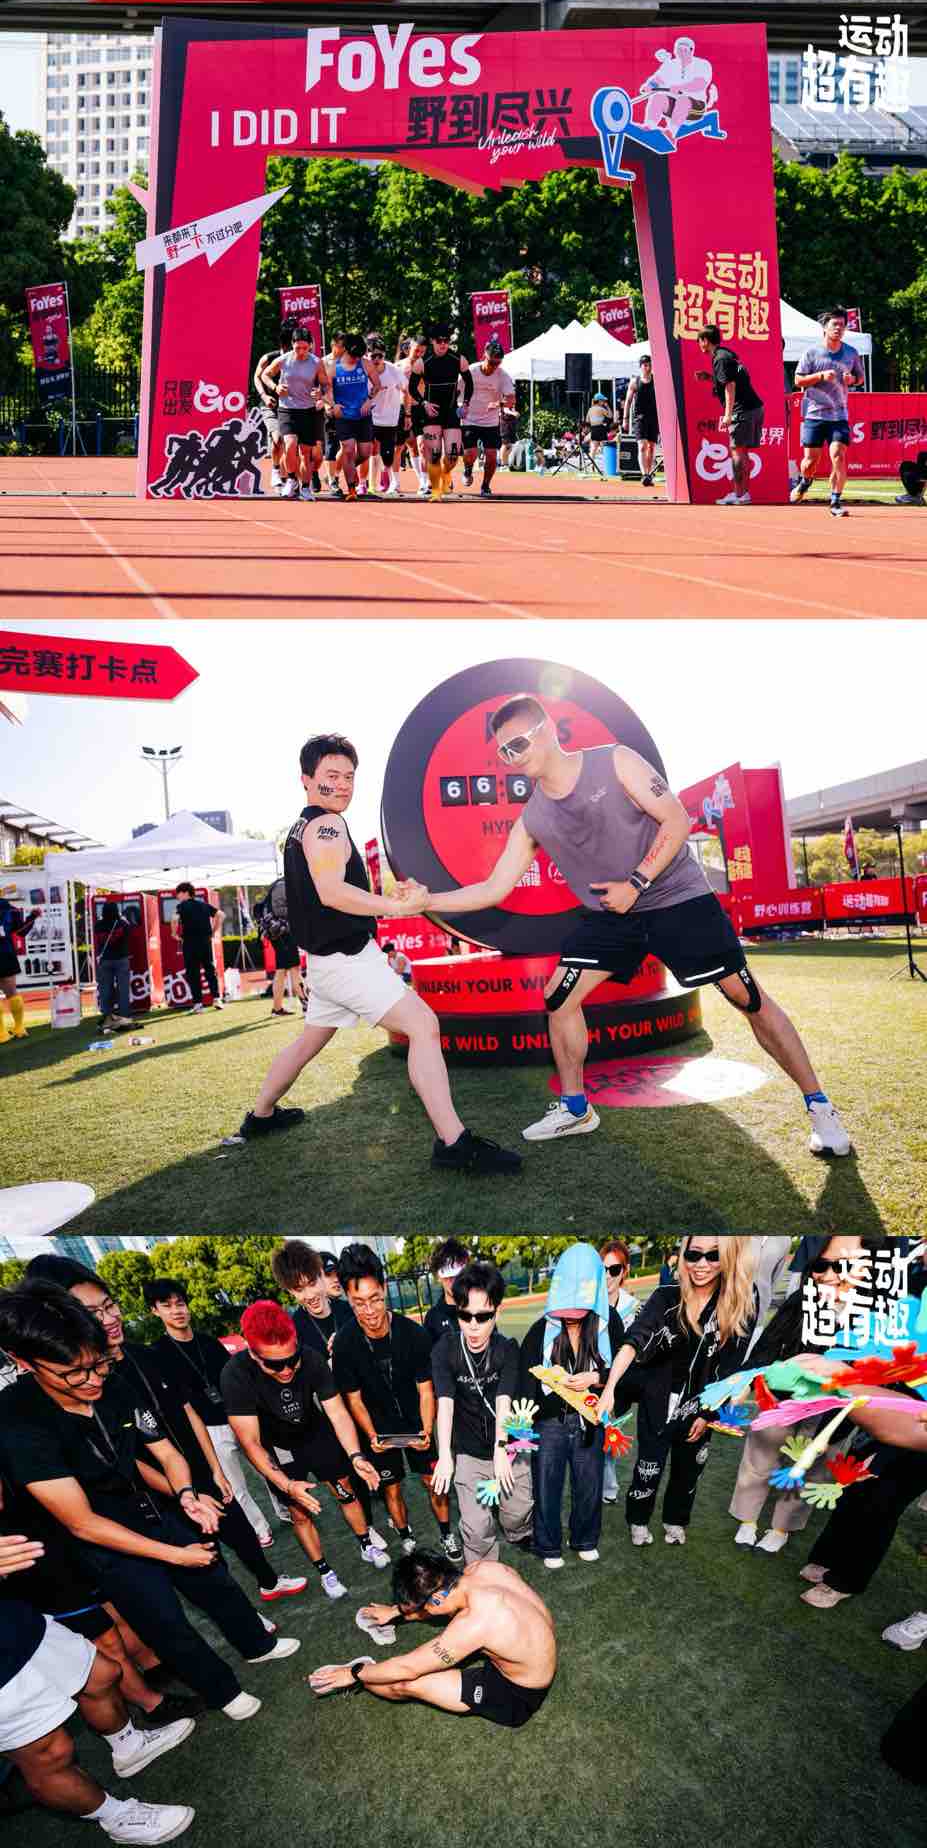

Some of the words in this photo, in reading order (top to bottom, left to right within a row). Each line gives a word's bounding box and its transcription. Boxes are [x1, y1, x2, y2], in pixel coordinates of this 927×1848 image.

[305, 23, 484, 92] FoYes
[211, 111, 220, 146] I
[233, 109, 297, 145] DID
[310, 107, 346, 143] IT
[408, 88, 572, 144] 野到尽兴
[478, 124, 539, 150] Unleash
[489, 142, 525, 164] your
[528, 128, 557, 150] wild
[166, 234, 202, 259] 野一下
[206, 220, 244, 245] 不过分吧
[705, 251, 769, 297] 运动
[31, 295, 64, 312] FoYes
[284, 296, 317, 312] FoYes
[476, 301, 507, 316] FoYes
[601, 308, 630, 324] FoYes
[672, 279, 769, 341] 超有趣
[194, 379, 245, 413] Go
[0, 645, 160, 684] 完赛打卡点
[754, 900, 813, 918] 野心训练营
[464, 978, 512, 994] YOUR
[456, 1033, 499, 1051] WILD
[608, 1018, 653, 1041] YOUR
[656, 1012, 685, 1032] WILD
